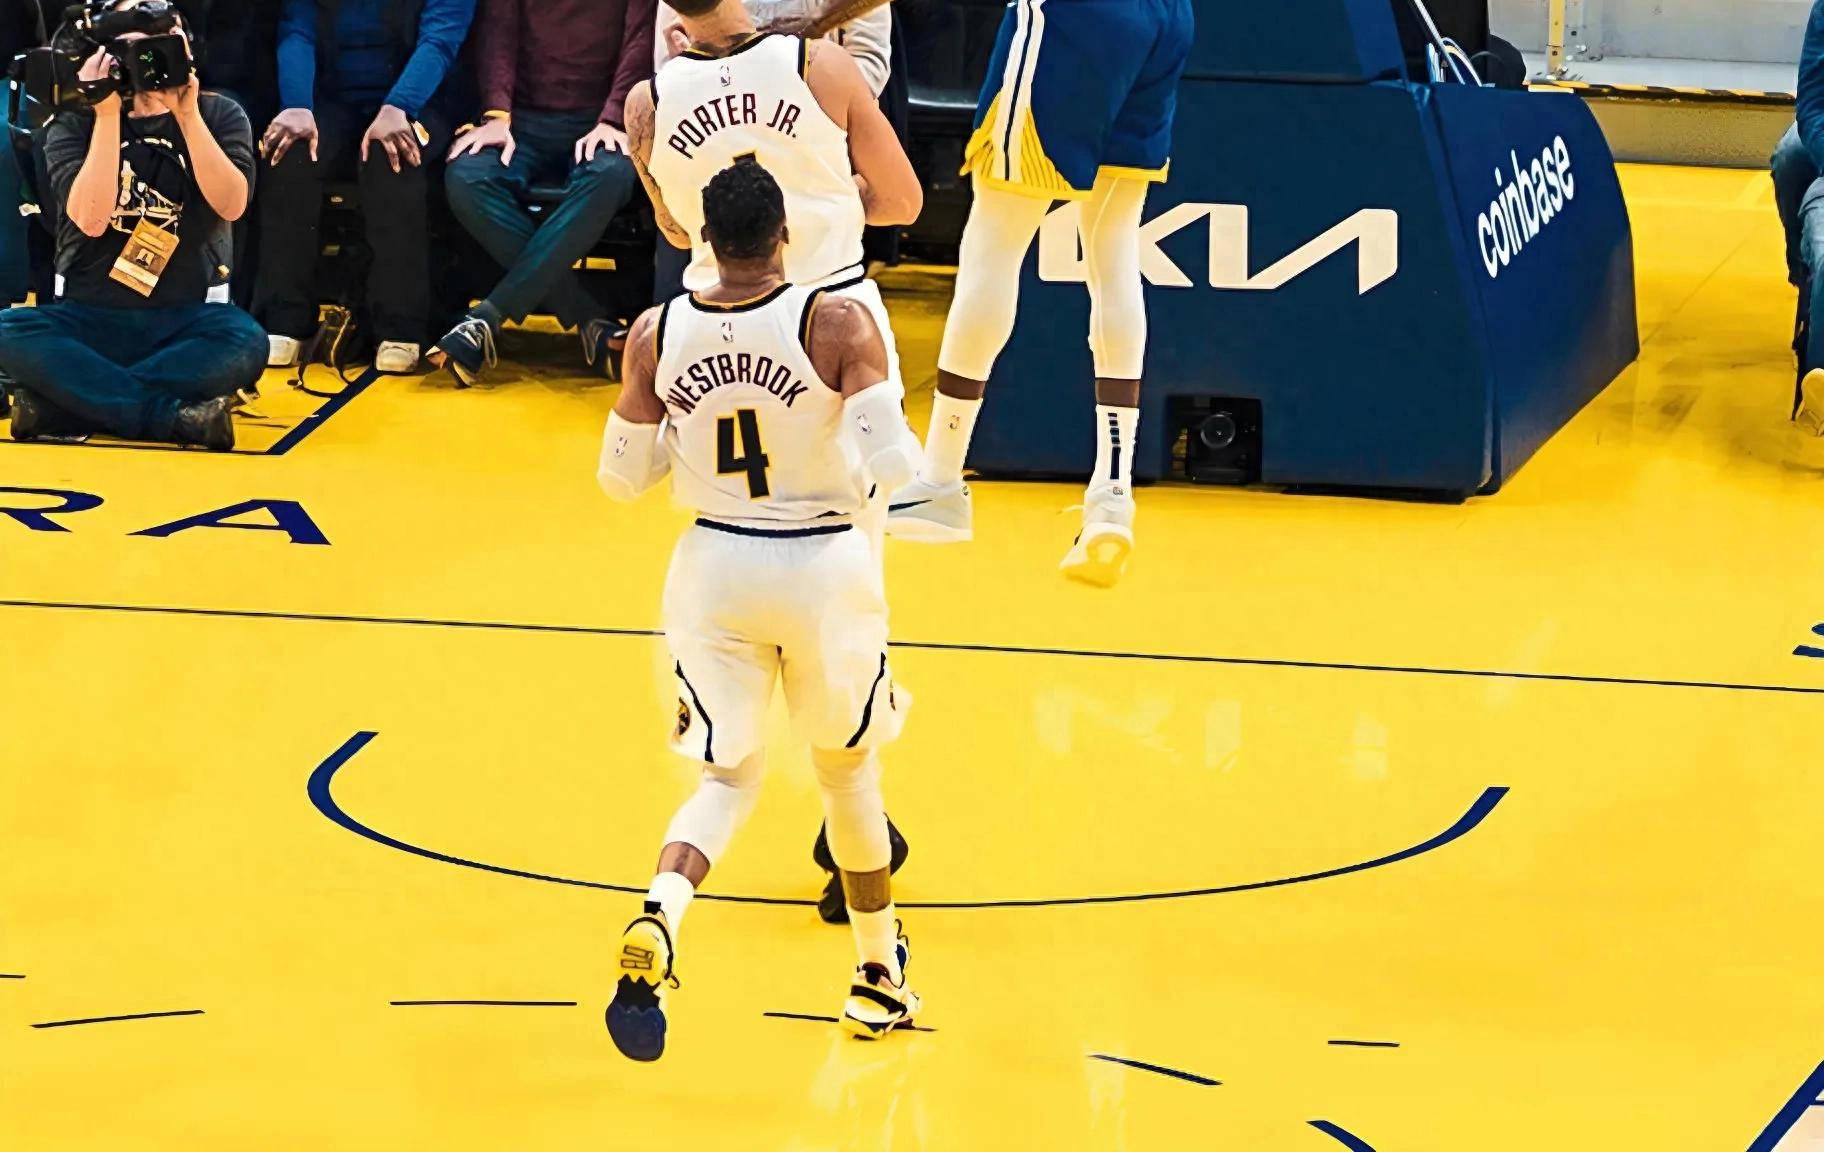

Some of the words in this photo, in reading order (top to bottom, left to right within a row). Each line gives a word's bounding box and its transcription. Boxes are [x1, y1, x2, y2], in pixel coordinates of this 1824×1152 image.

[668, 93, 757, 160] PORTER
[766, 99, 801, 138] JR.
[1478, 135, 1575, 278] coinbase
[666, 353, 809, 414] WESTBROOK
[716, 407, 771, 500] 4
